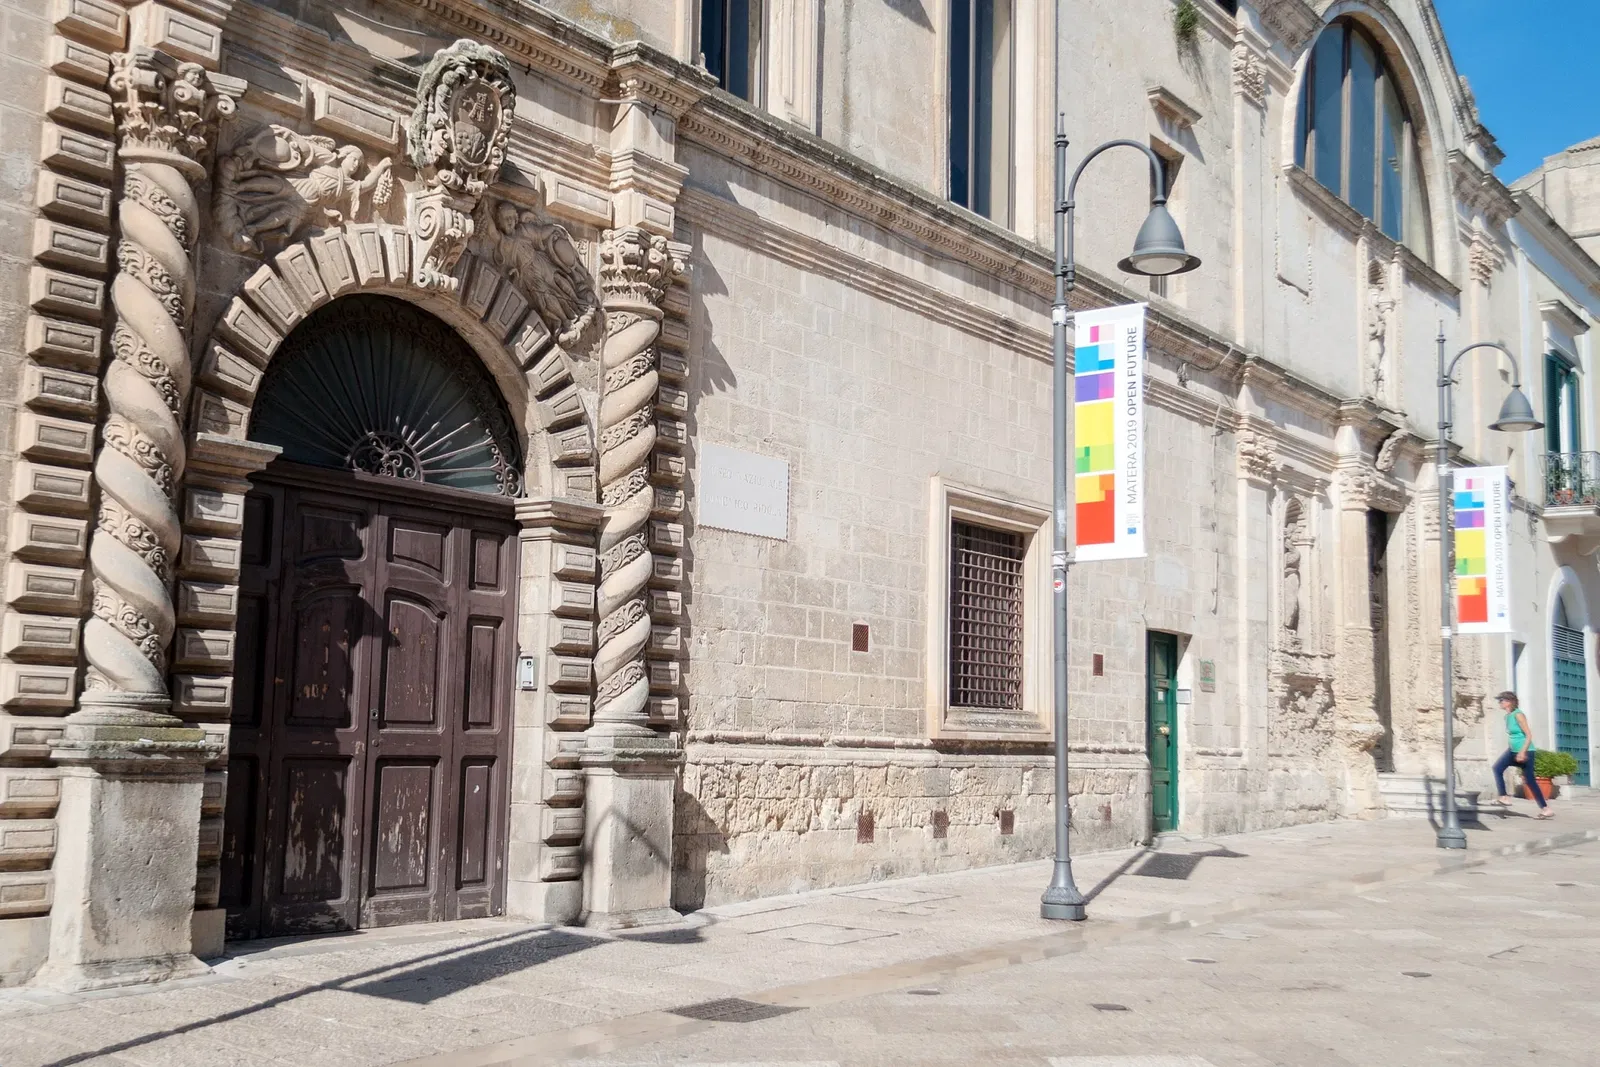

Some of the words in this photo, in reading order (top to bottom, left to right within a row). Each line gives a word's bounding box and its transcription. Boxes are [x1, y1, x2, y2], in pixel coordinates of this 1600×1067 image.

[1126, 326, 1137, 377] FUTURE
[1126, 381, 1137, 416] OPEN
[1126, 419, 1137, 449] 2019
[1126, 452, 1137, 504] MATERA
[1492, 480, 1501, 513] FUTURE
[1493, 516, 1502, 540] OPEN
[1495, 564, 1504, 598] MATERA
